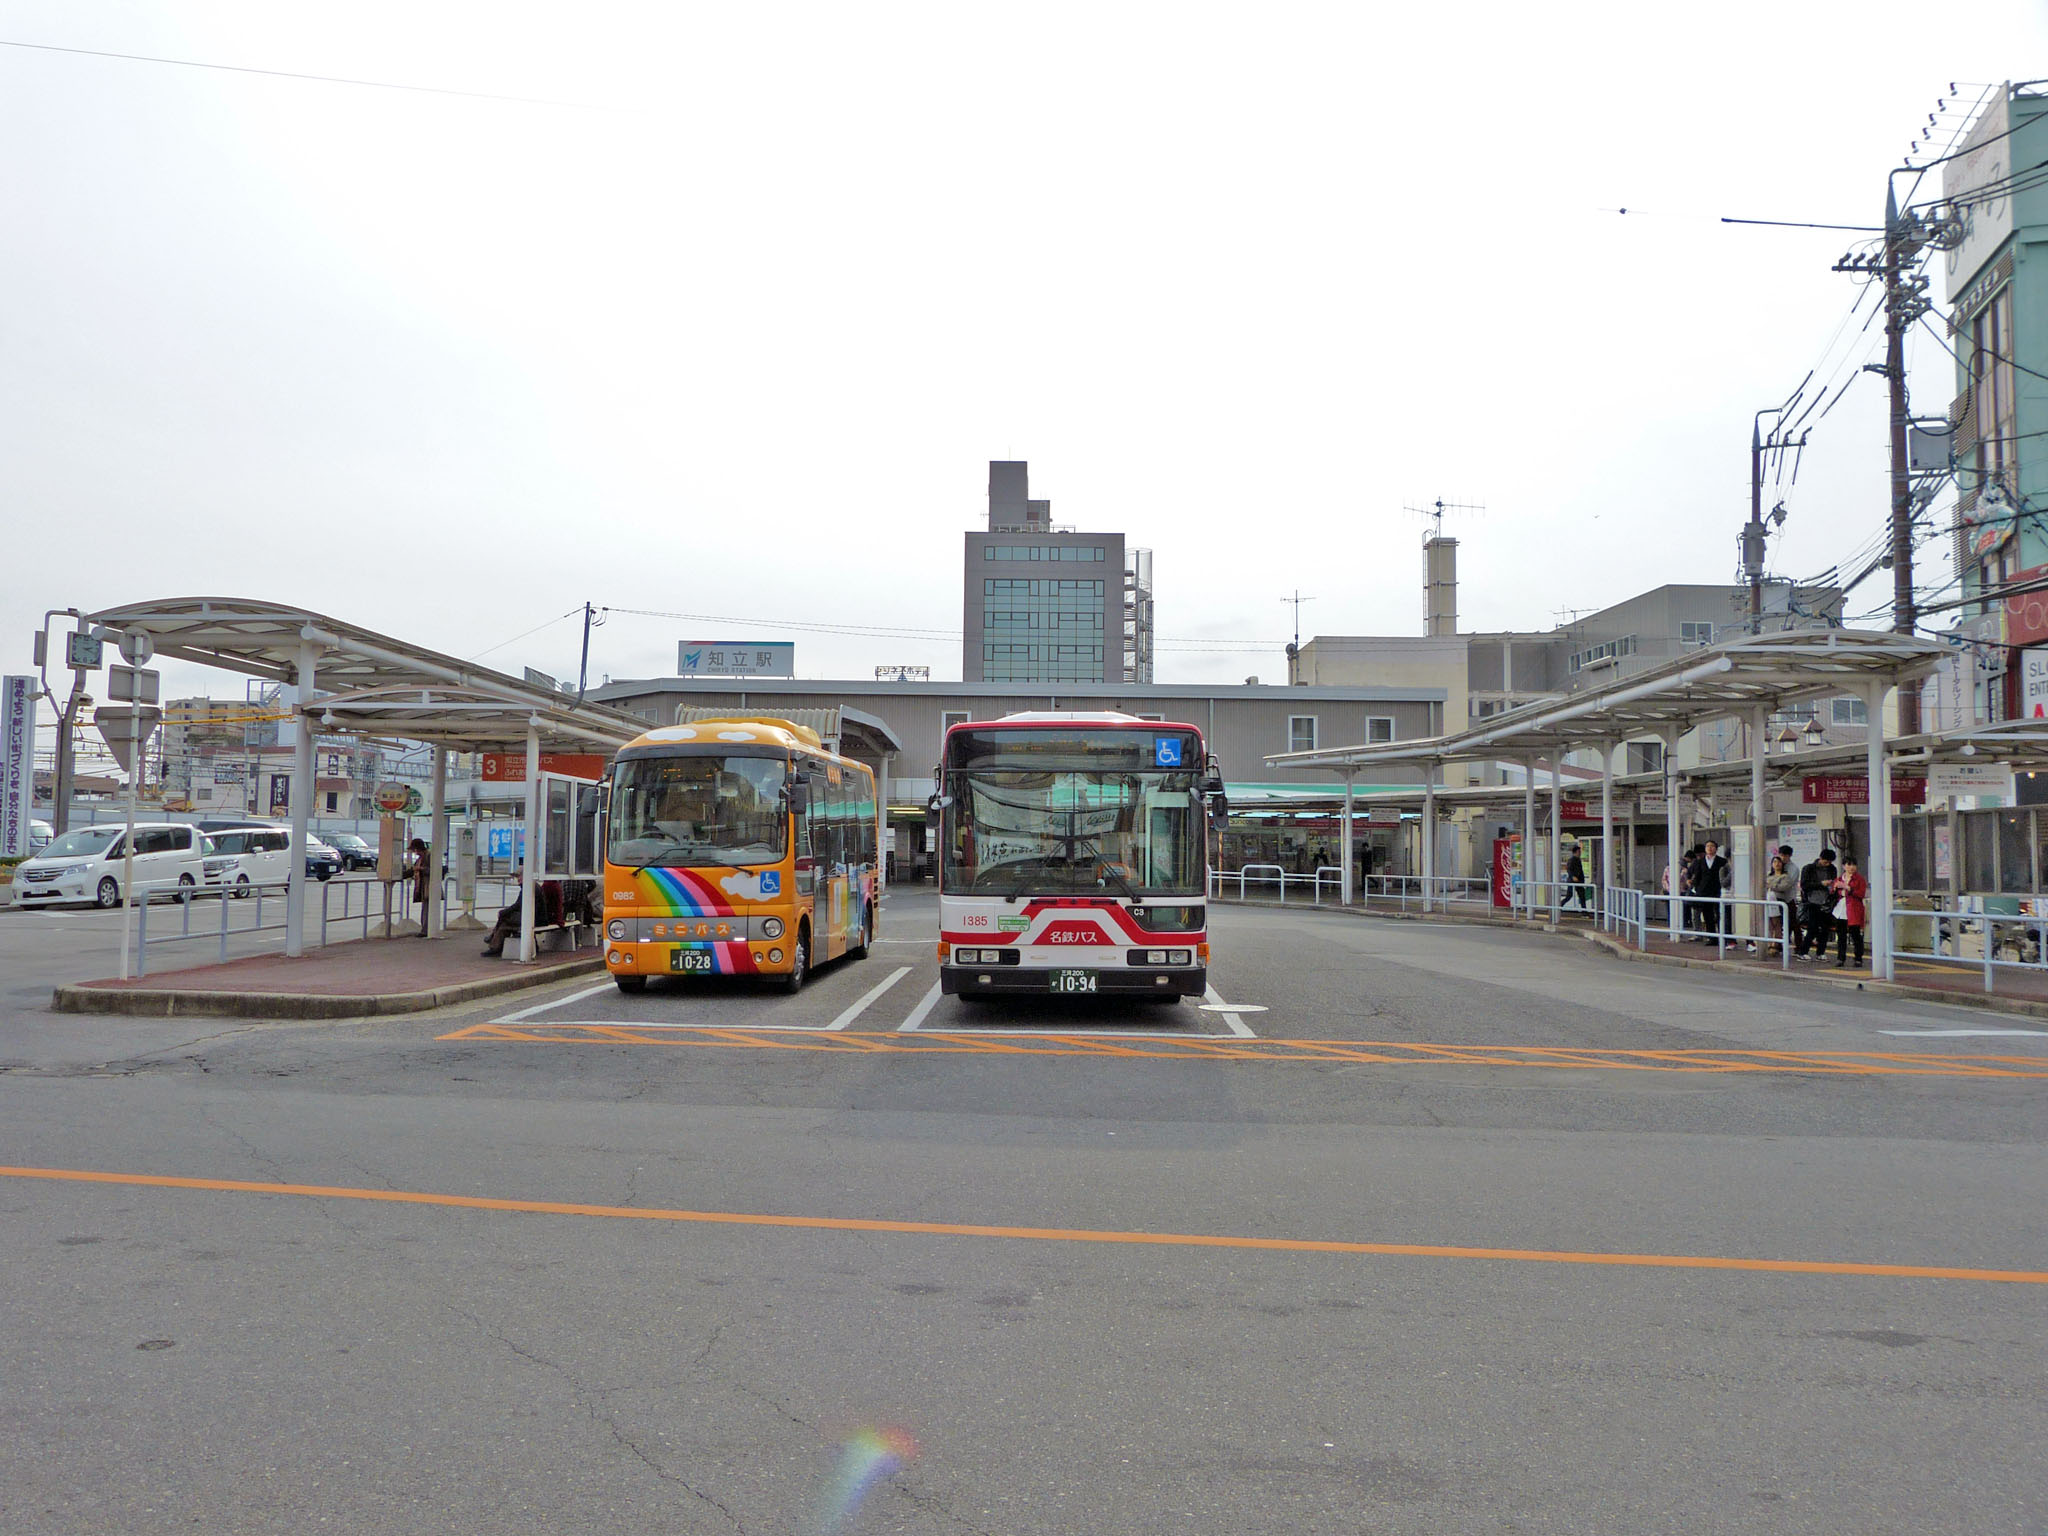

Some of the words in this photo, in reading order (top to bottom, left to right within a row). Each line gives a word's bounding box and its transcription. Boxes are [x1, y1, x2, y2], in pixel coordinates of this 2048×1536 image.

[708, 650, 773, 667] 知立駅
[2029, 661, 2048, 678] SL
[2029, 680, 2048, 697] ENT
[486, 759, 497, 775] 3
[1808, 782, 1817, 798] 1
[963, 915, 988, 926] 1385
[655, 924, 731, 935] ミニバス
[1050, 931, 1097, 943] 名鉄バス
